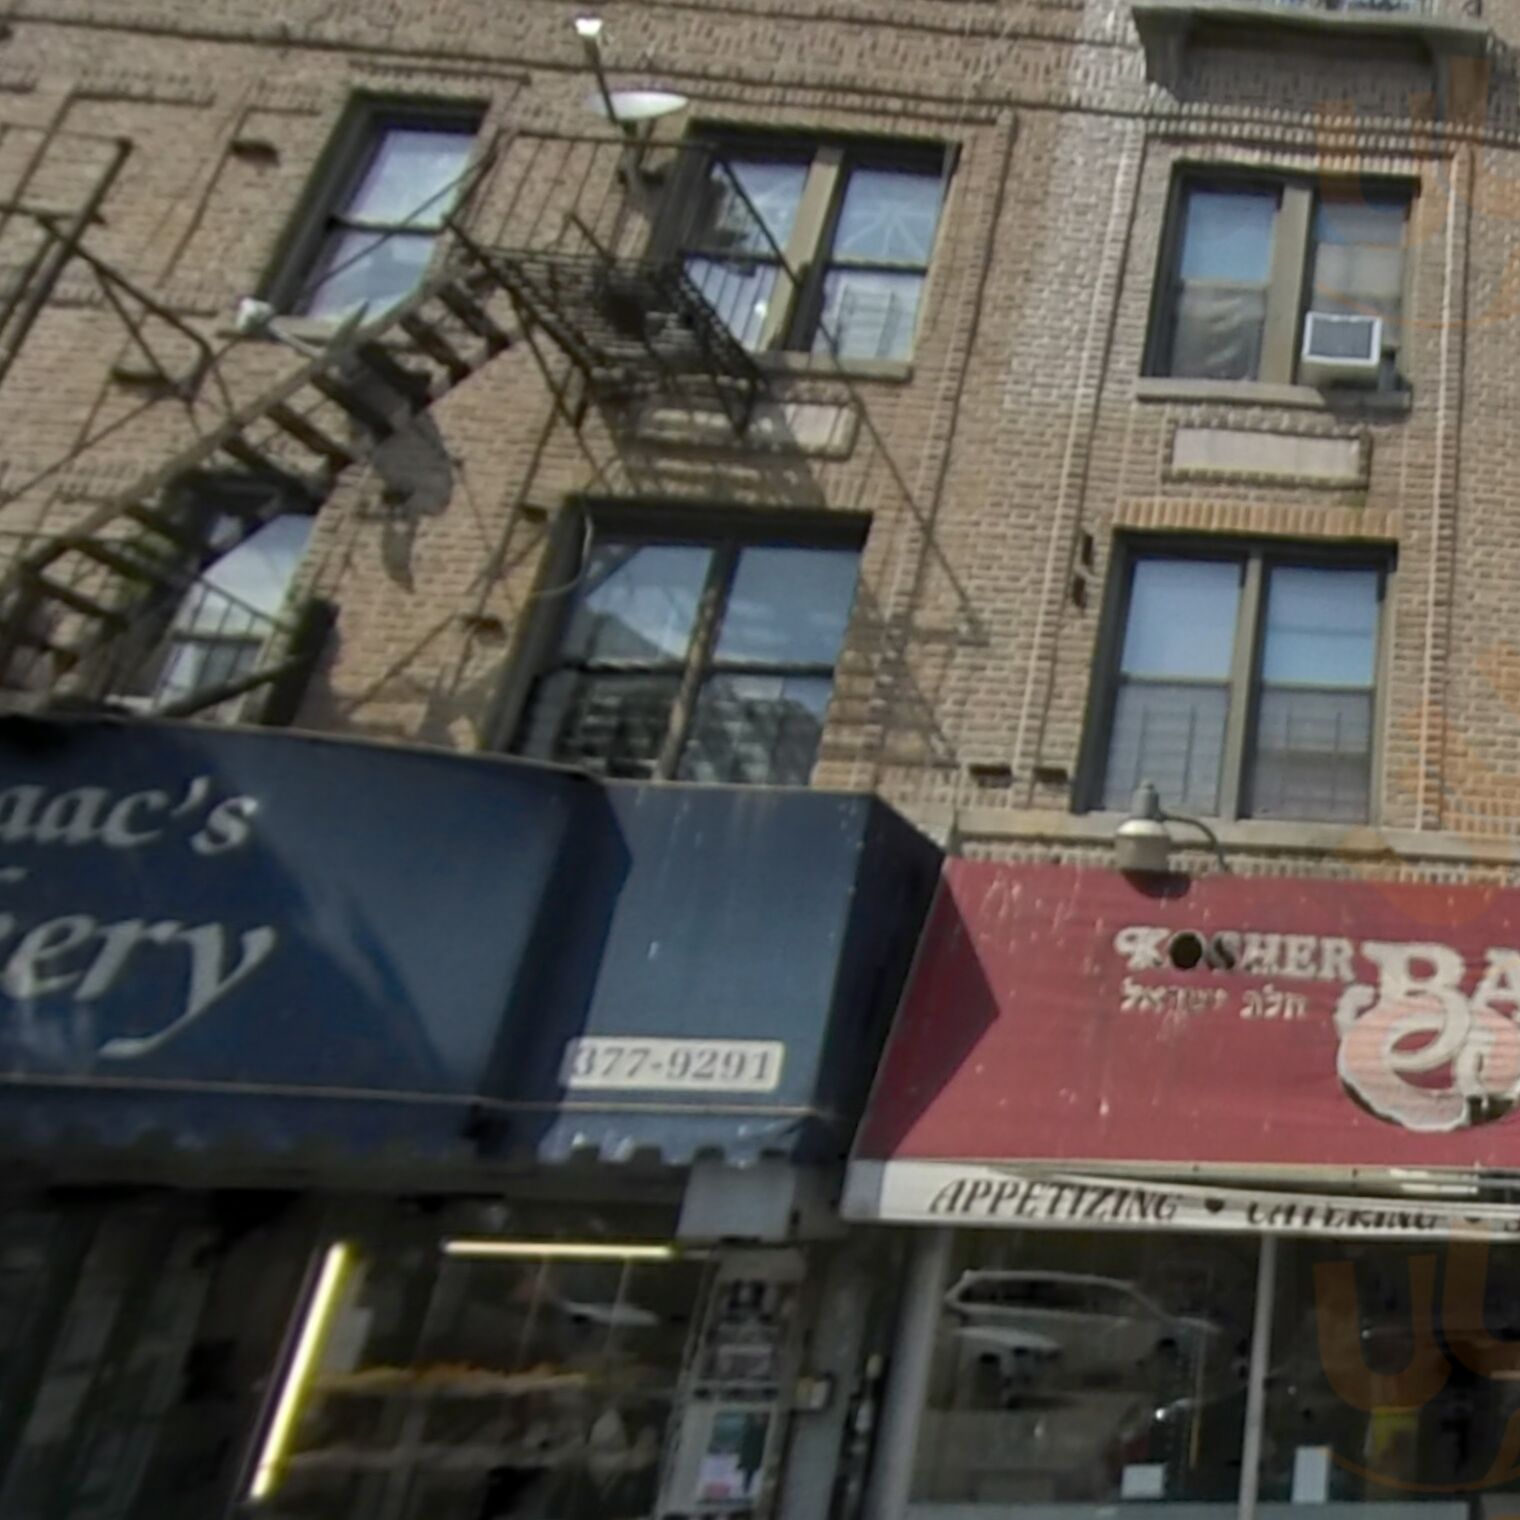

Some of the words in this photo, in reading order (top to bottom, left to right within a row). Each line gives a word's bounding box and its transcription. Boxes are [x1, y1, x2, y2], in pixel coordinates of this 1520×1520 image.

[1114, 925, 1355, 983] KOSHER
[0, 905, 279, 1060] ery
[573, 1048, 774, 1083] 377-9291
[929, 1178, 1181, 1224] APPETIZING
